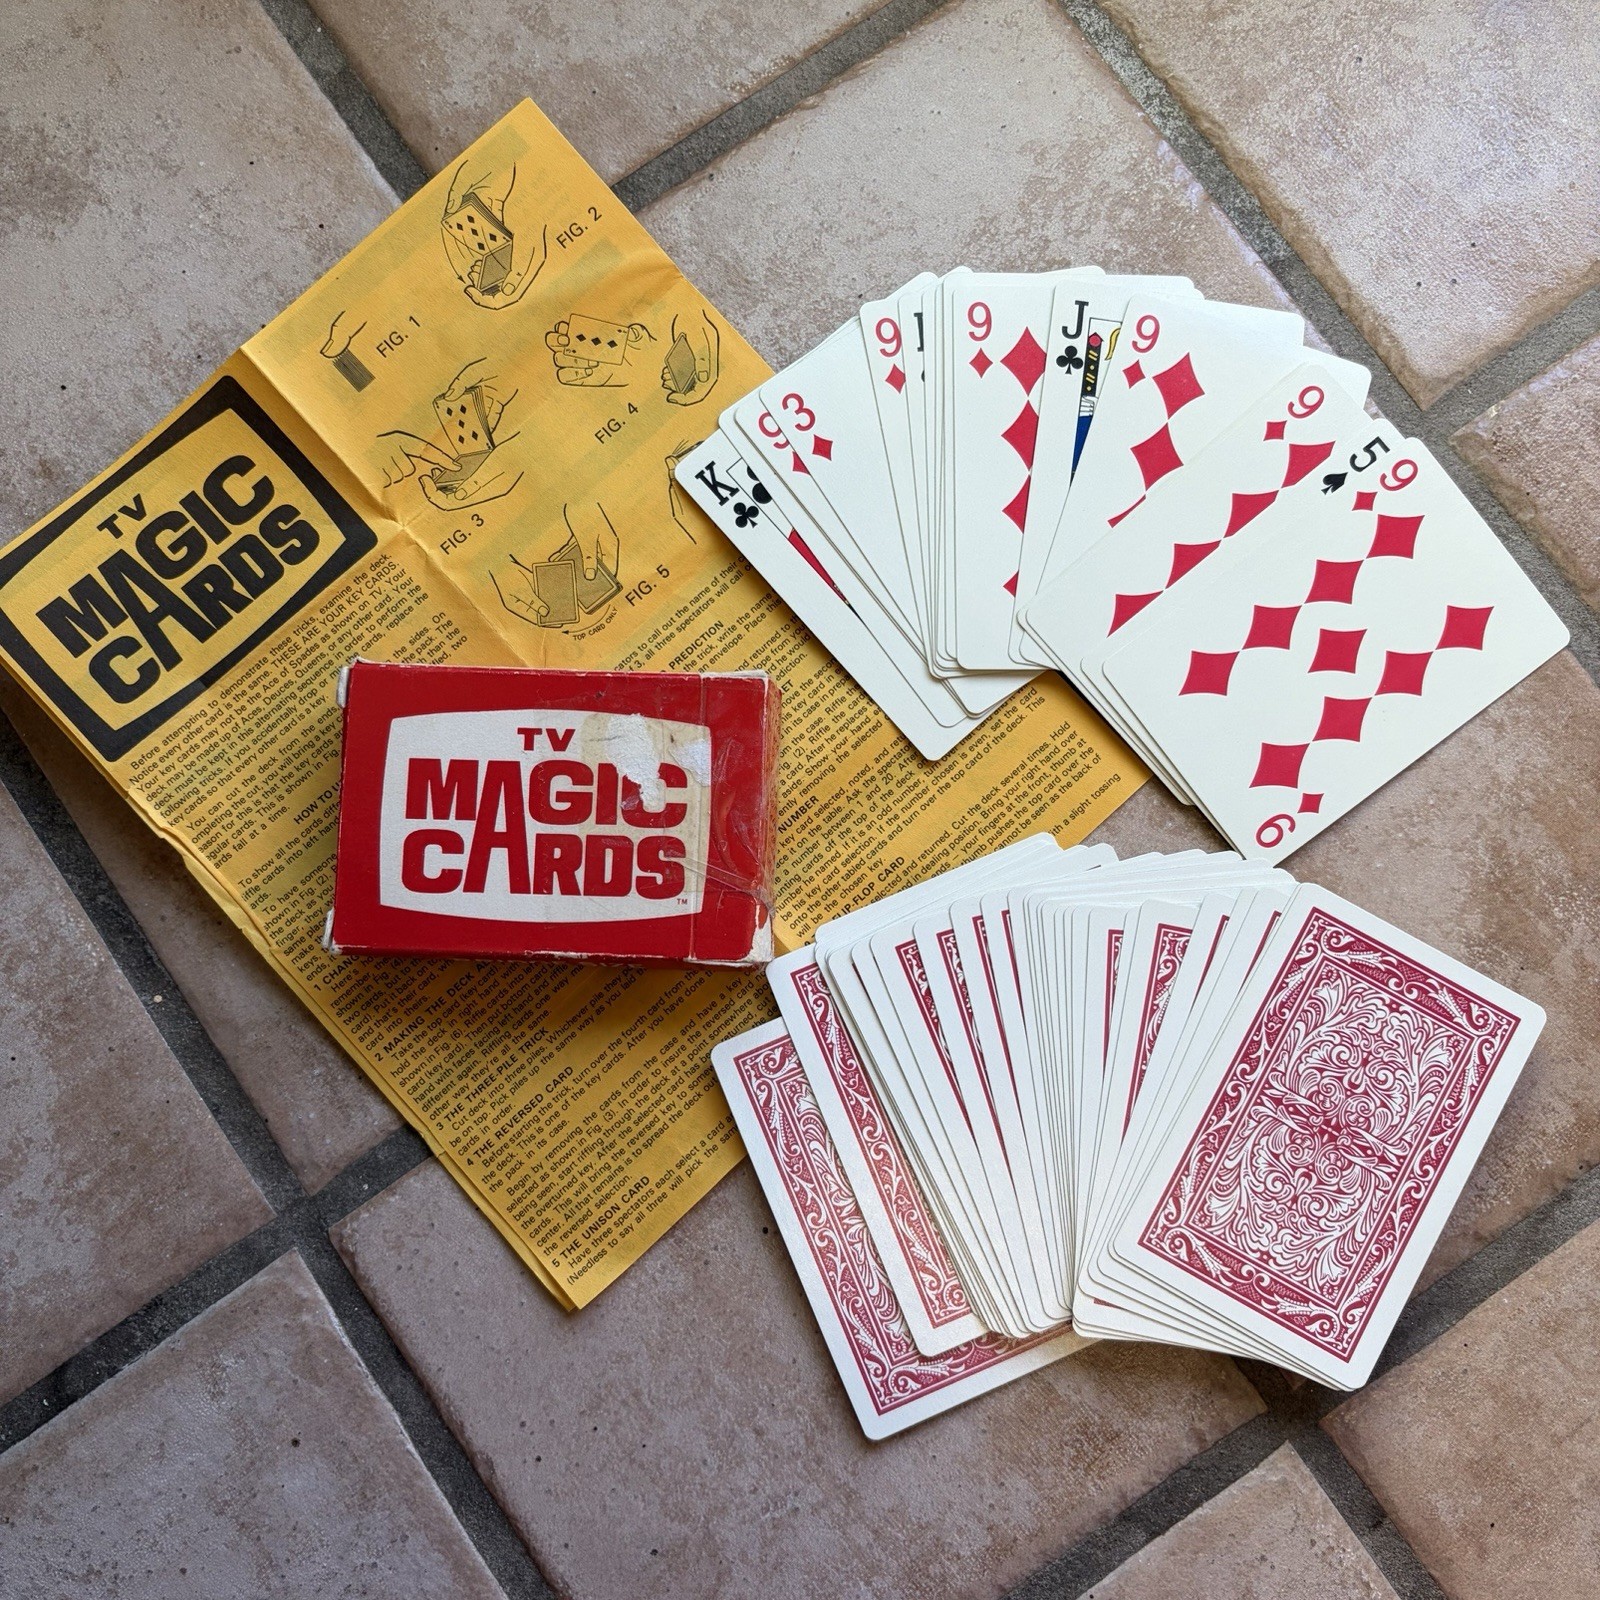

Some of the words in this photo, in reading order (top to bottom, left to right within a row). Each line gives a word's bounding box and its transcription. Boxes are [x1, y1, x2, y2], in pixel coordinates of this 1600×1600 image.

[556, 221, 588, 249] FIG.
[588, 206, 602, 222] 2
[376, 331, 408, 358] FIG.
[408, 316, 421, 328] 1
[875, 318, 901, 358] 9
[967, 302, 992, 342] 9
[1062, 300, 1089, 340] J
[1132, 315, 1160, 353] 9
[594, 418, 626, 444] FIG.
[627, 402, 639, 415] 4
[782, 393, 816, 431] 3
[1287, 386, 1324, 419] 9
[758, 411, 790, 449] 9
[1349, 436, 1391, 473] 5
[1380, 459, 1418, 492] 9
[694, 460, 740, 506] K
[96, 493, 147, 539] TV
[440, 526, 472, 556] FIG.
[471, 513, 485, 528] 3
[36, 454, 275, 672] MAGIC
[624, 580, 657, 607] FIG.
[656, 564, 670, 579] 5
[88, 504, 320, 704] CARDS
[572, 632, 586, 641] TOP
[588, 623, 606, 636] CARD
[606, 606, 618, 624] ONLY
[637, 642, 648, 652] to
[647, 628, 662, 644] call
[661, 616, 676, 631] out
[674, 605, 690, 618] the
[688, 586, 711, 607] name
[710, 576, 720, 588] of
[719, 561, 737, 579] their
[130, 745, 160, 770] Before
[161, 708, 208, 746] attempting
[207, 699, 219, 709] to
[219, 656, 269, 700] demonstrate
[269, 636, 292, 657] these
[292, 616, 319, 636] tricks,
[319, 585, 352, 615] examine
[352, 572, 368, 585] the
[369, 554, 392, 572] deck.
[668, 620, 724, 670] PREDICTION
[128, 761, 159, 786] Notice
[158, 742, 182, 763] every
[182, 724, 205, 744] other
[204, 707, 224, 726] card
[222, 701, 233, 710] is
[232, 689, 248, 703] the
[247, 670, 273, 691] same.
[270, 641, 302, 668] THESE
[301, 625, 321, 645] ARE
[319, 603, 347, 627] YOUR
[345, 587, 364, 606] KEY
[364, 561, 400, 590] CARDS.
[136, 774, 159, 793] Your
[158, 761, 176, 776] key
[176, 742, 201, 763] cards
[200, 727, 219, 744] may
[219, 713, 236, 729] not
[233, 704, 247, 716] be
[246, 691, 262, 705] the
[262, 677, 280, 693] Ace
[279, 665, 290, 678] of
[288, 642, 320, 669] Spades
[319, 633, 331, 644] as
[330, 610, 358, 635] shown
[357, 600, 371, 611] on
[368, 586, 386, 600] TV.
[384, 568, 406, 586] Your
[517, 728, 576, 752] TV
[293, 800, 318, 825] HOW
[316, 789, 333, 803] TO
[406, 758, 688, 845] MAGIC
[777, 795, 819, 834] NUMBER
[779, 910, 793, 922] be
[791, 898, 806, 912] his
[804, 884, 822, 900] key
[822, 865, 840, 885] card
[840, 836, 878, 868] selection.
[876, 824, 886, 834] If
[885, 813, 900, 827] the
[900, 785, 930, 814] number
[930, 759, 959, 786] chosen
[959, 751, 968, 760] is
[968, 733, 991, 752] even,
[990, 718, 1004, 732] set
[1003, 705, 1018, 719] the
[1019, 686, 1038, 705] card
[901, 859, 918, 877] and
[917, 829, 953, 862] returned.
[951, 815, 968, 830] Cut
[966, 803, 982, 817] the
[980, 786, 1001, 804] deck
[999, 759, 1028, 787] several
[1026, 741, 1051, 762] times.
[1049, 720, 1071, 741] Hold
[1062, 818, 1070, 826] a
[1068, 798, 1092, 820] slight
[1090, 773, 1121, 800] tossing
[237, 877, 253, 888] To
[251, 857, 275, 880] show
[274, 847, 286, 860] all
[284, 837, 301, 850] the
[300, 817, 323, 838] cards
[402, 812, 686, 900] CARDS
[374, 1052, 384, 1062] 2
[382, 1015, 425, 1054] MAKING
[424, 996, 446, 1015] THE
[446, 972, 474, 997] DECK
[435, 1121, 444, 1131] 3
[443, 1102, 465, 1122] THE
[464, 1053, 518, 1103] THREE-PILE
[517, 1026, 548, 1054] TRICK
[481, 1142, 510, 1168] Before
[508, 1114, 541, 1144] starting
[538, 1102, 553, 1116] the
[551, 1085, 574, 1103] trick,
[572, 1067, 591, 1085] turn
[589, 1050, 608, 1069] over
[607, 1037, 623, 1052] the
[621, 1015, 647, 1039] fourth
[647, 997, 665, 1016] card
[664, 980, 685, 998] from
[466, 1157, 474, 1166] 4
[472, 1138, 495, 1158] THE
[494, 1093, 544, 1140] REVERSED
[545, 1066, 573, 1093] CARD
[505, 1173, 531, 1197] Begin
[530, 1161, 544, 1174] by
[544, 1125, 584, 1162] removing
[582, 1111, 598, 1126] the
[598, 1089, 622, 1112] cards
[621, 1070, 643, 1089] from
[643, 1055, 658, 1070] the
[659, 1036, 678, 1055] case
[679, 1018, 696, 1036] and
[567, 1247, 592, 1269] Have
[590, 1226, 614, 1248] three
[613, 1187, 655, 1228] spectators
[654, 1168, 676, 1189] each
[675, 1145, 700, 1170] select
[699, 1139, 707, 1148] a
[706, 1120, 725, 1140] card
[551, 1257, 560, 1268] 5
[559, 1238, 582, 1259] THE
[581, 1202, 621, 1240] UNISON
[621, 1175, 650, 1204] CARD
